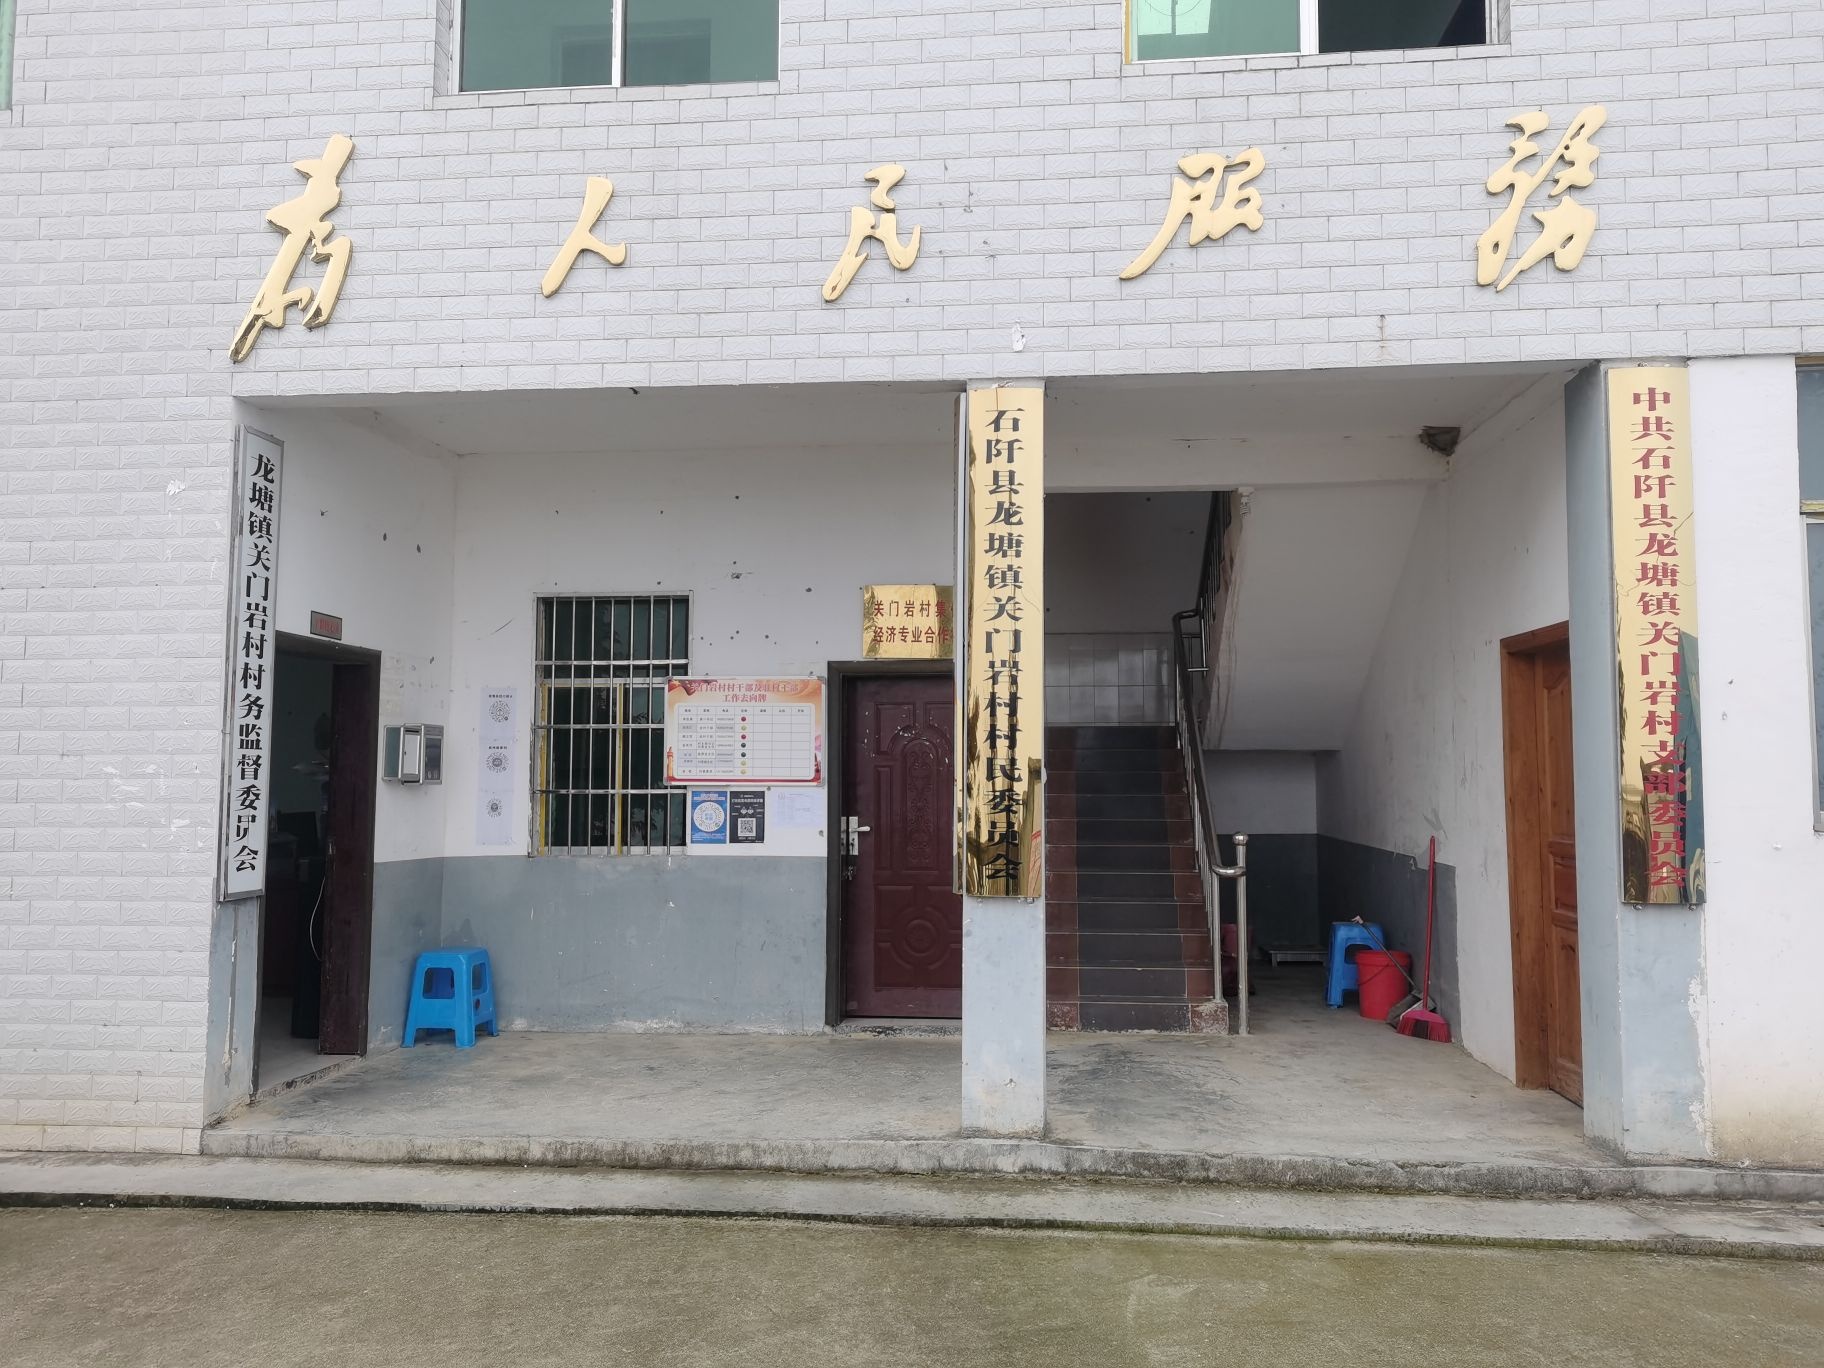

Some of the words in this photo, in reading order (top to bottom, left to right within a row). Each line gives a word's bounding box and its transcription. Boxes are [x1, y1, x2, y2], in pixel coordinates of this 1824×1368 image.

[872, 625, 953, 644] 经济专业合作
[873, 599, 953, 618] 关门岩村集
[983, 407, 1025, 880] 石阡县龙塘镇关门岩村村民委员会
[1630, 386, 1687, 888] 中共石阡县龙塘镇关门岩村支部委员会
